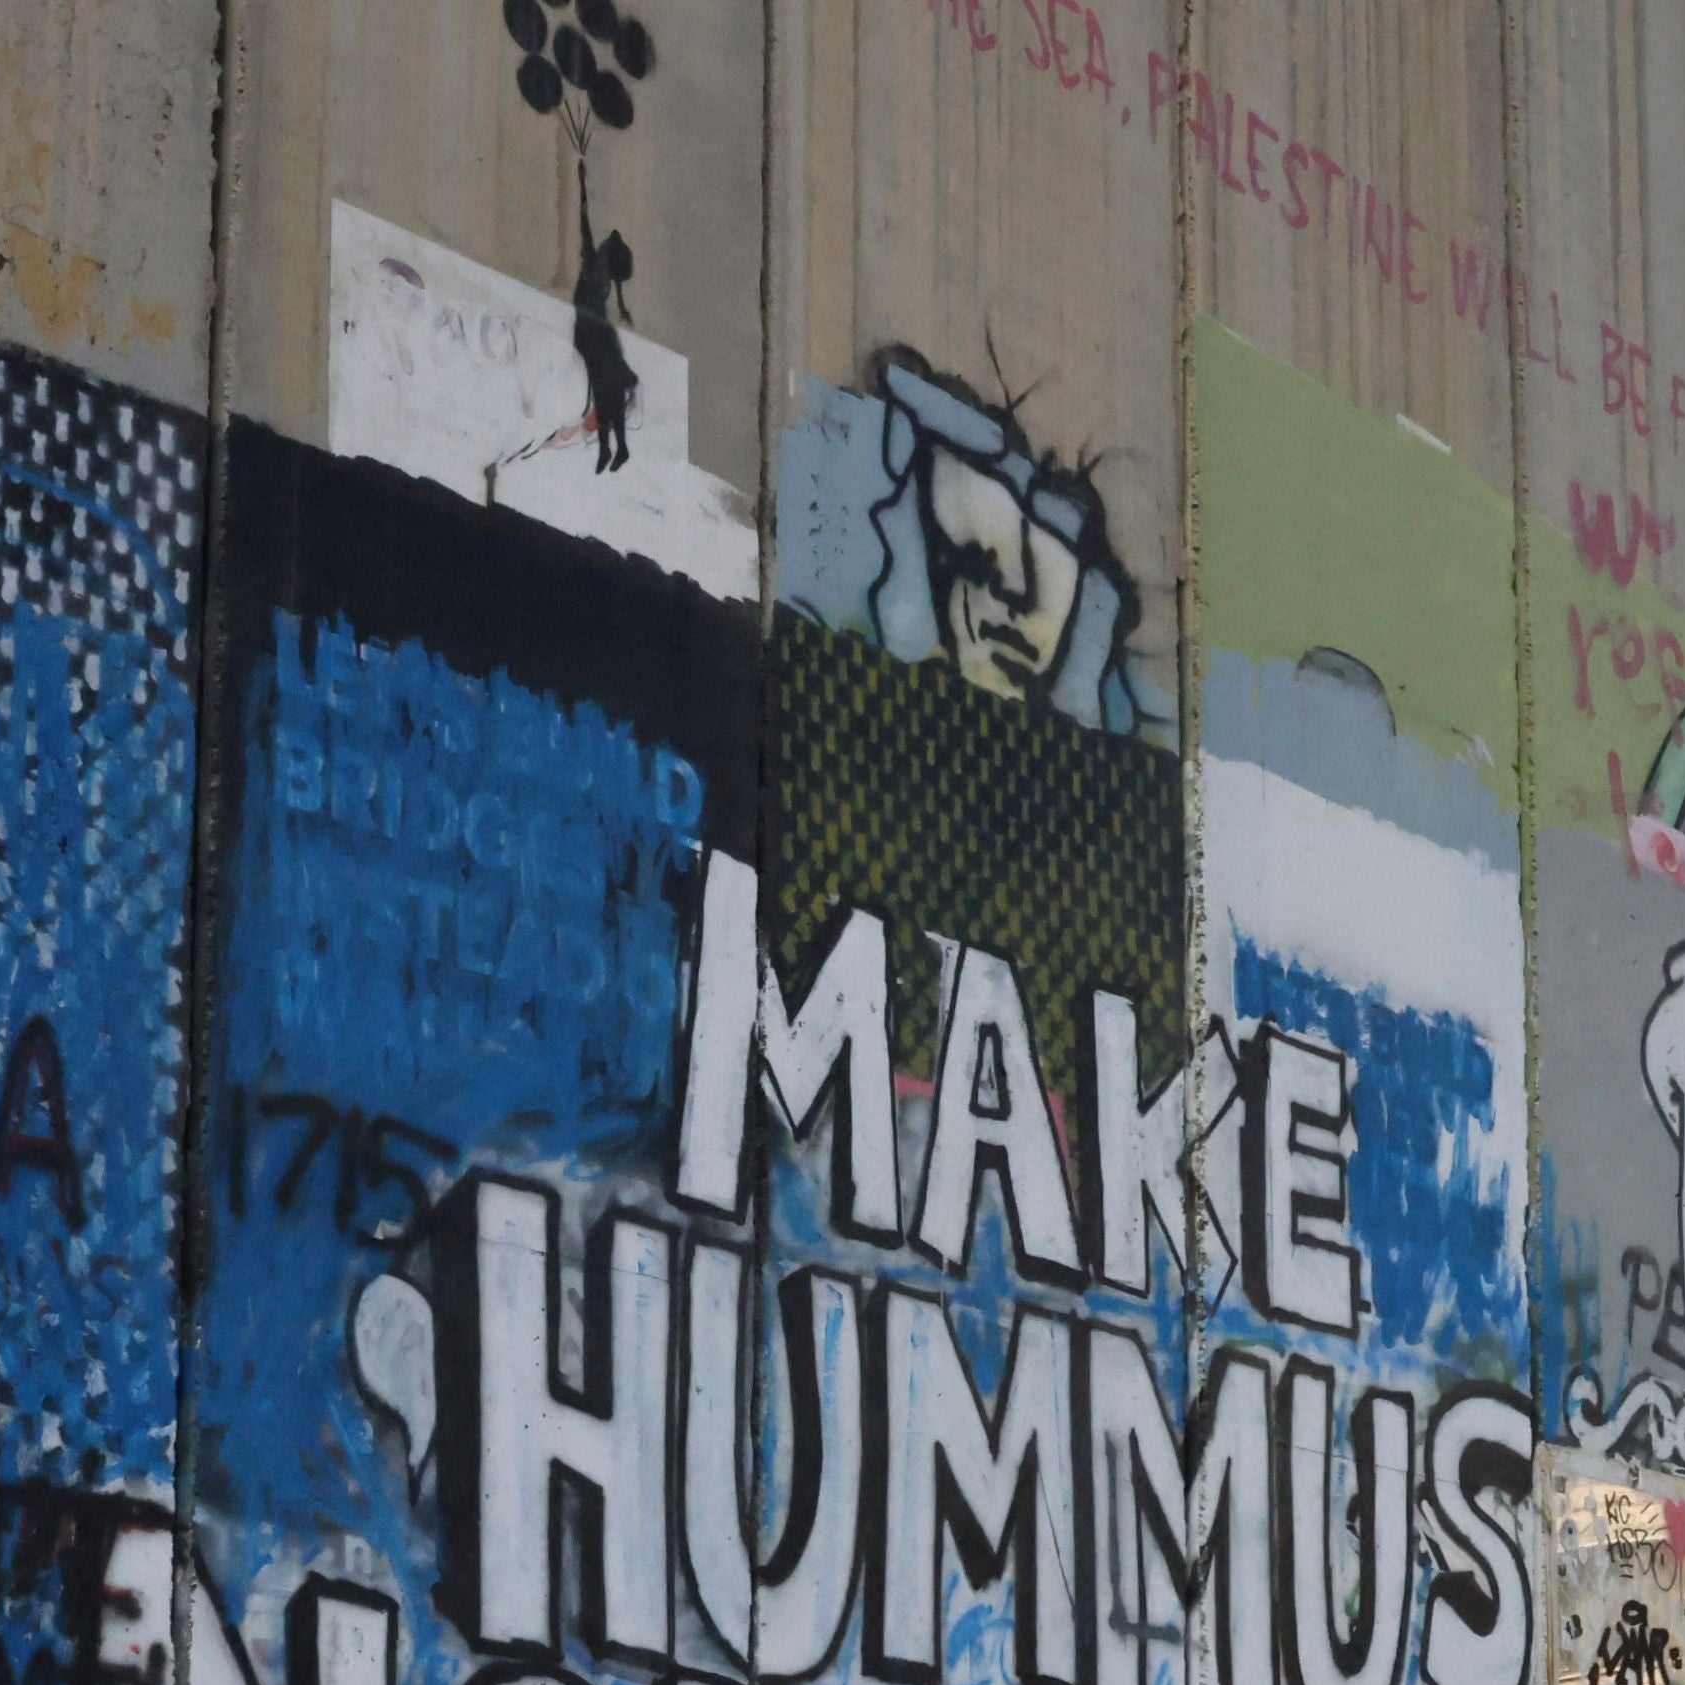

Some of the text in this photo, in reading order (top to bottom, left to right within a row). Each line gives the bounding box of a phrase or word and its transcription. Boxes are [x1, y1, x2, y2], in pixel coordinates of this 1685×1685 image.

[1147, 50, 1427, 305] PALESTINE
[1449, 236, 1578, 386] WILL
[1599, 320, 1655, 438] BE
[665, 845, 1372, 1340] MAKE
